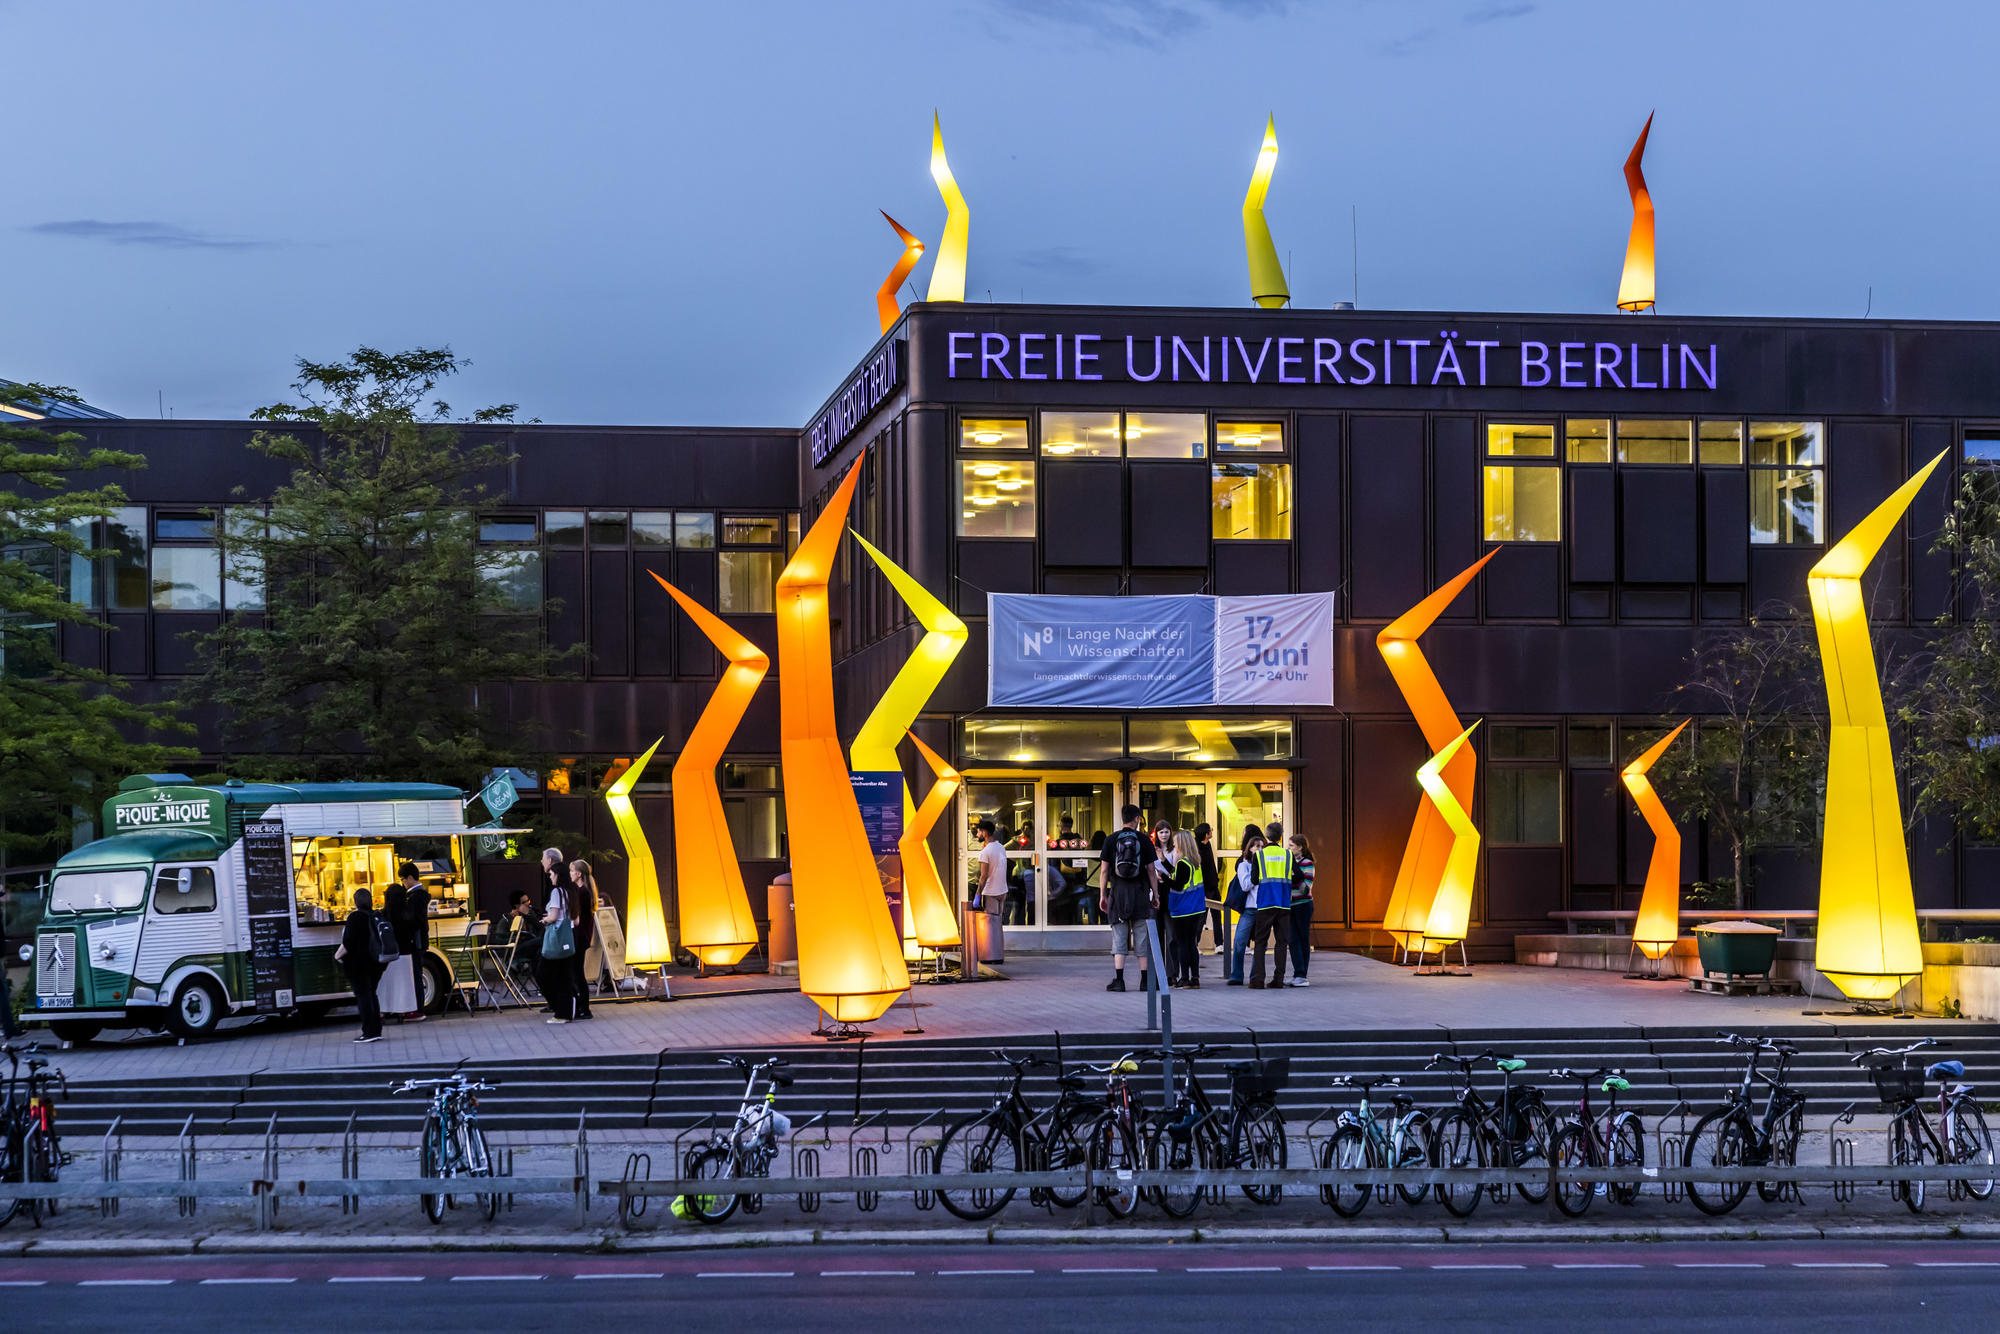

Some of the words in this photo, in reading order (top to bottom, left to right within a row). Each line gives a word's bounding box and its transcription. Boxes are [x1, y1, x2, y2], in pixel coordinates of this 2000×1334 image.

[948, 332, 1103, 380] FREIE
[1126, 330, 1500, 386] UNIVERSITÄT
[1521, 341, 1717, 389] BERLIN
[827, 367, 869, 453] UNIVERSITÄT
[870, 339, 897, 409] BERLIN
[1067, 627, 1111, 643] Lange
[1115, 627, 1157, 640] Nacht
[1160, 627, 1185, 640] der
[1244, 616, 1281, 639] 17.
[1023, 626, 1053, 656] N8
[1067, 643, 1185, 657] Wissenschaften
[1244, 642, 1309, 667] Juni
[1033, 672, 1177, 682] langenachtderwissenschaften.de
[1285, 671, 1308, 681] Uhr
[490, 790, 512, 807] VEGAN
[483, 833, 499, 848] BIO
